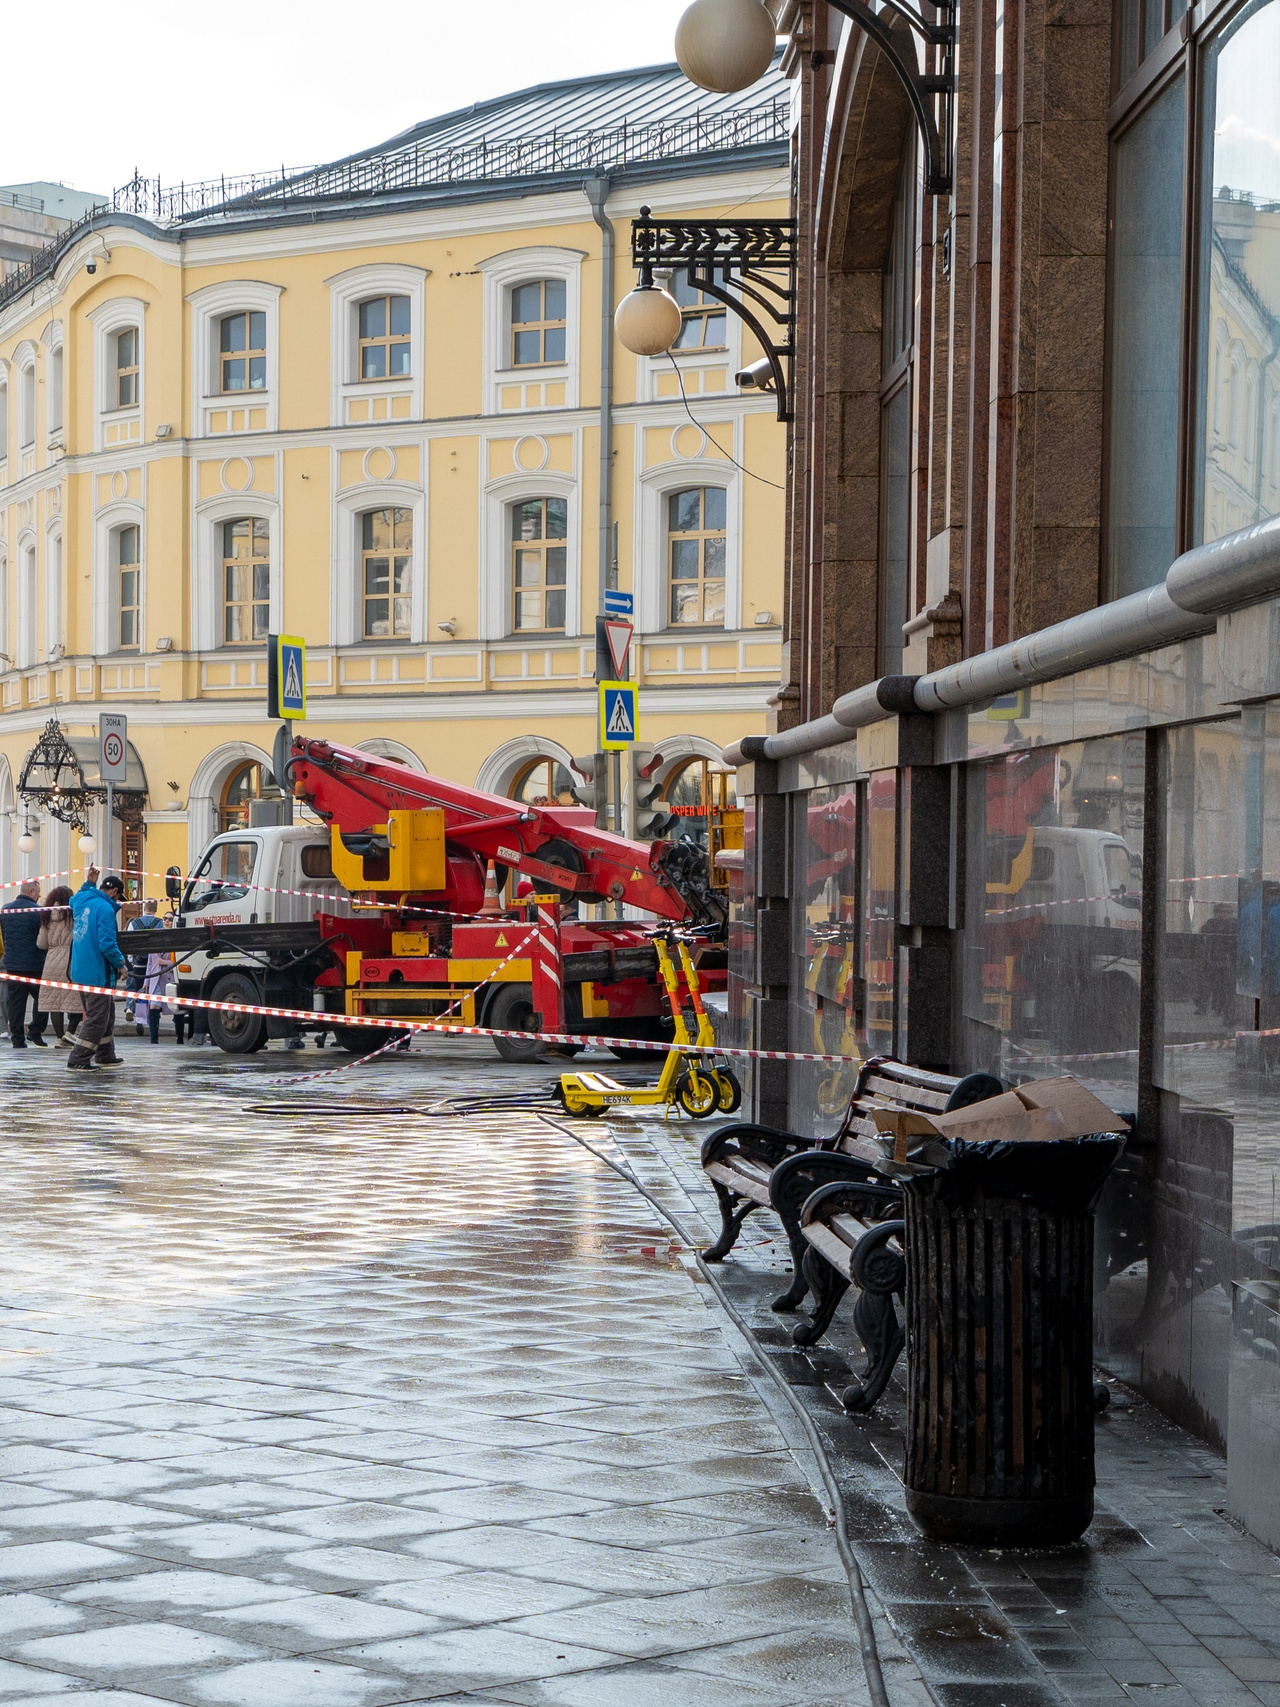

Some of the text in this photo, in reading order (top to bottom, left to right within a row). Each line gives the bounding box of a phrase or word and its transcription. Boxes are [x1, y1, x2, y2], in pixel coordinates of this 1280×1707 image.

[106, 718, 121, 727] ЗОНА
[108, 743, 119, 756] 50
[697, 805, 717, 816] WIE
